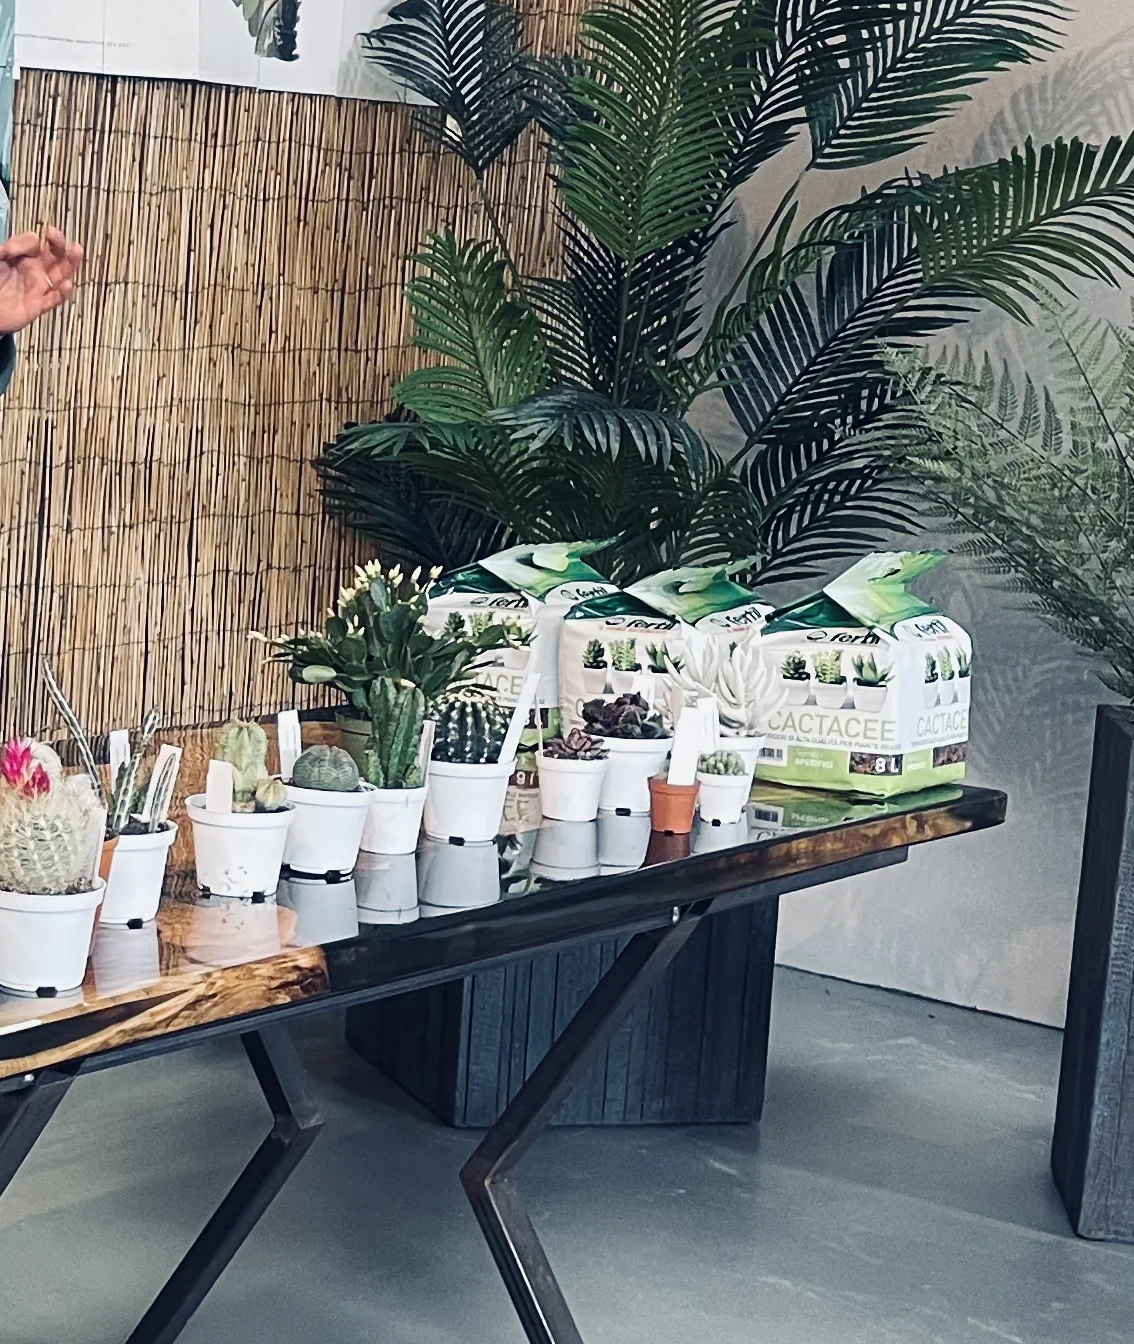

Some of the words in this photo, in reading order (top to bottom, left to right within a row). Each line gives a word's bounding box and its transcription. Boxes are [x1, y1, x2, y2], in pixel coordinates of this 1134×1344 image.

[767, 711, 897, 742] CACTACEE
[875, 756, 886, 773] 8
[890, 757, 899, 773] L
